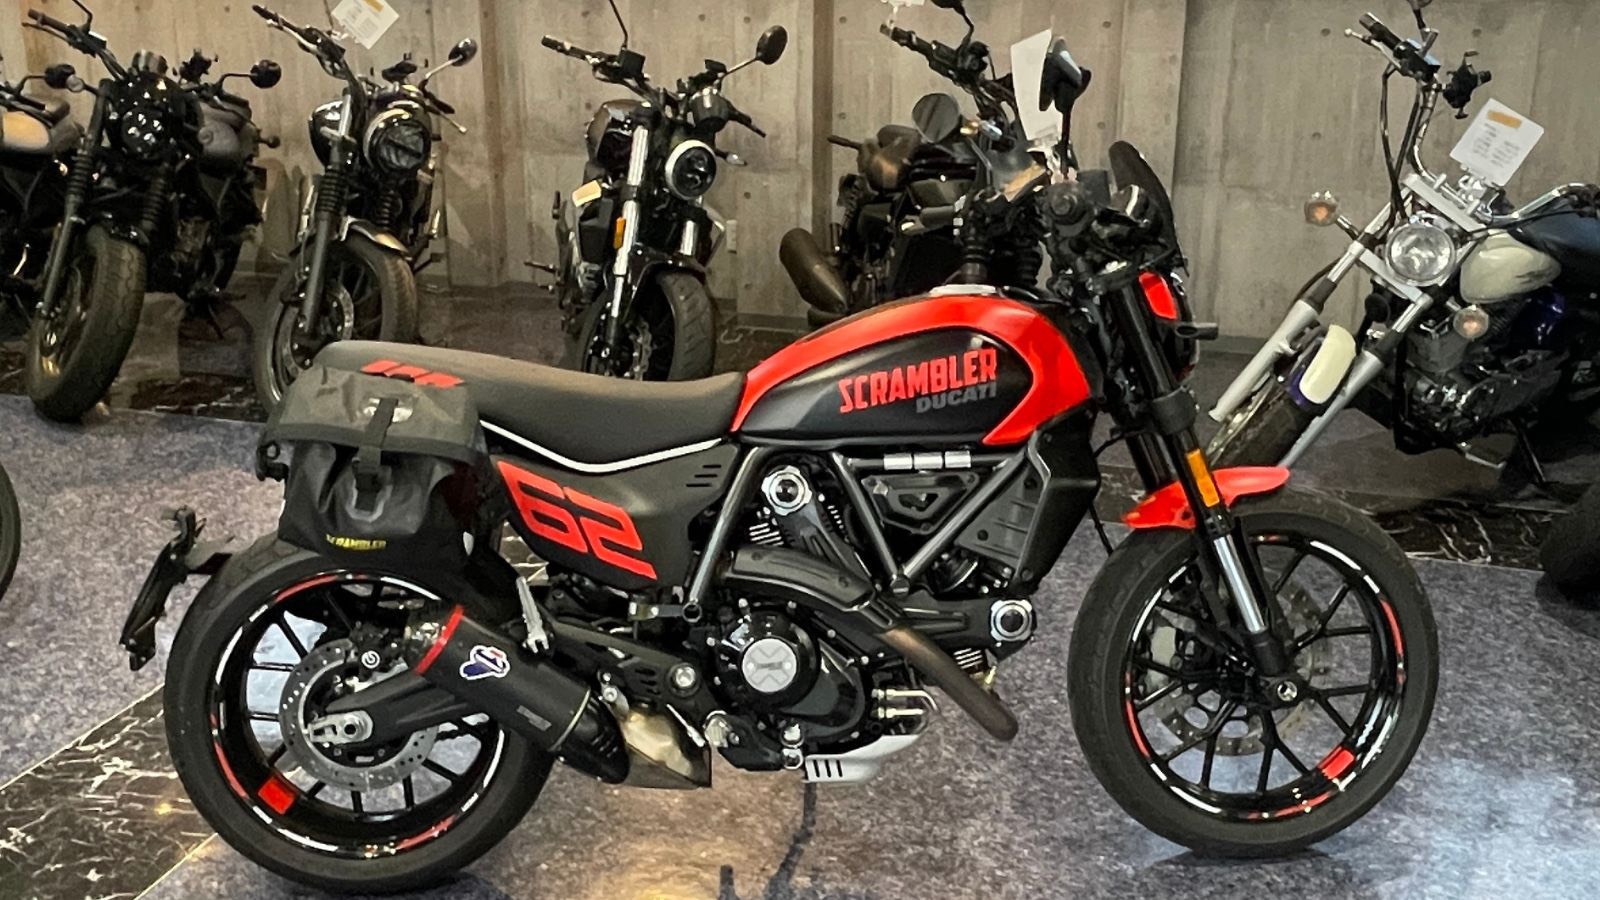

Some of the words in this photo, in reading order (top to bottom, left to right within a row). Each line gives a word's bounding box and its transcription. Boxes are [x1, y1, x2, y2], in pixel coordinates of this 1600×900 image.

[838, 347, 997, 413] SCRAMBLER
[916, 382, 998, 414] DUCATI
[497, 460, 658, 581] 62
